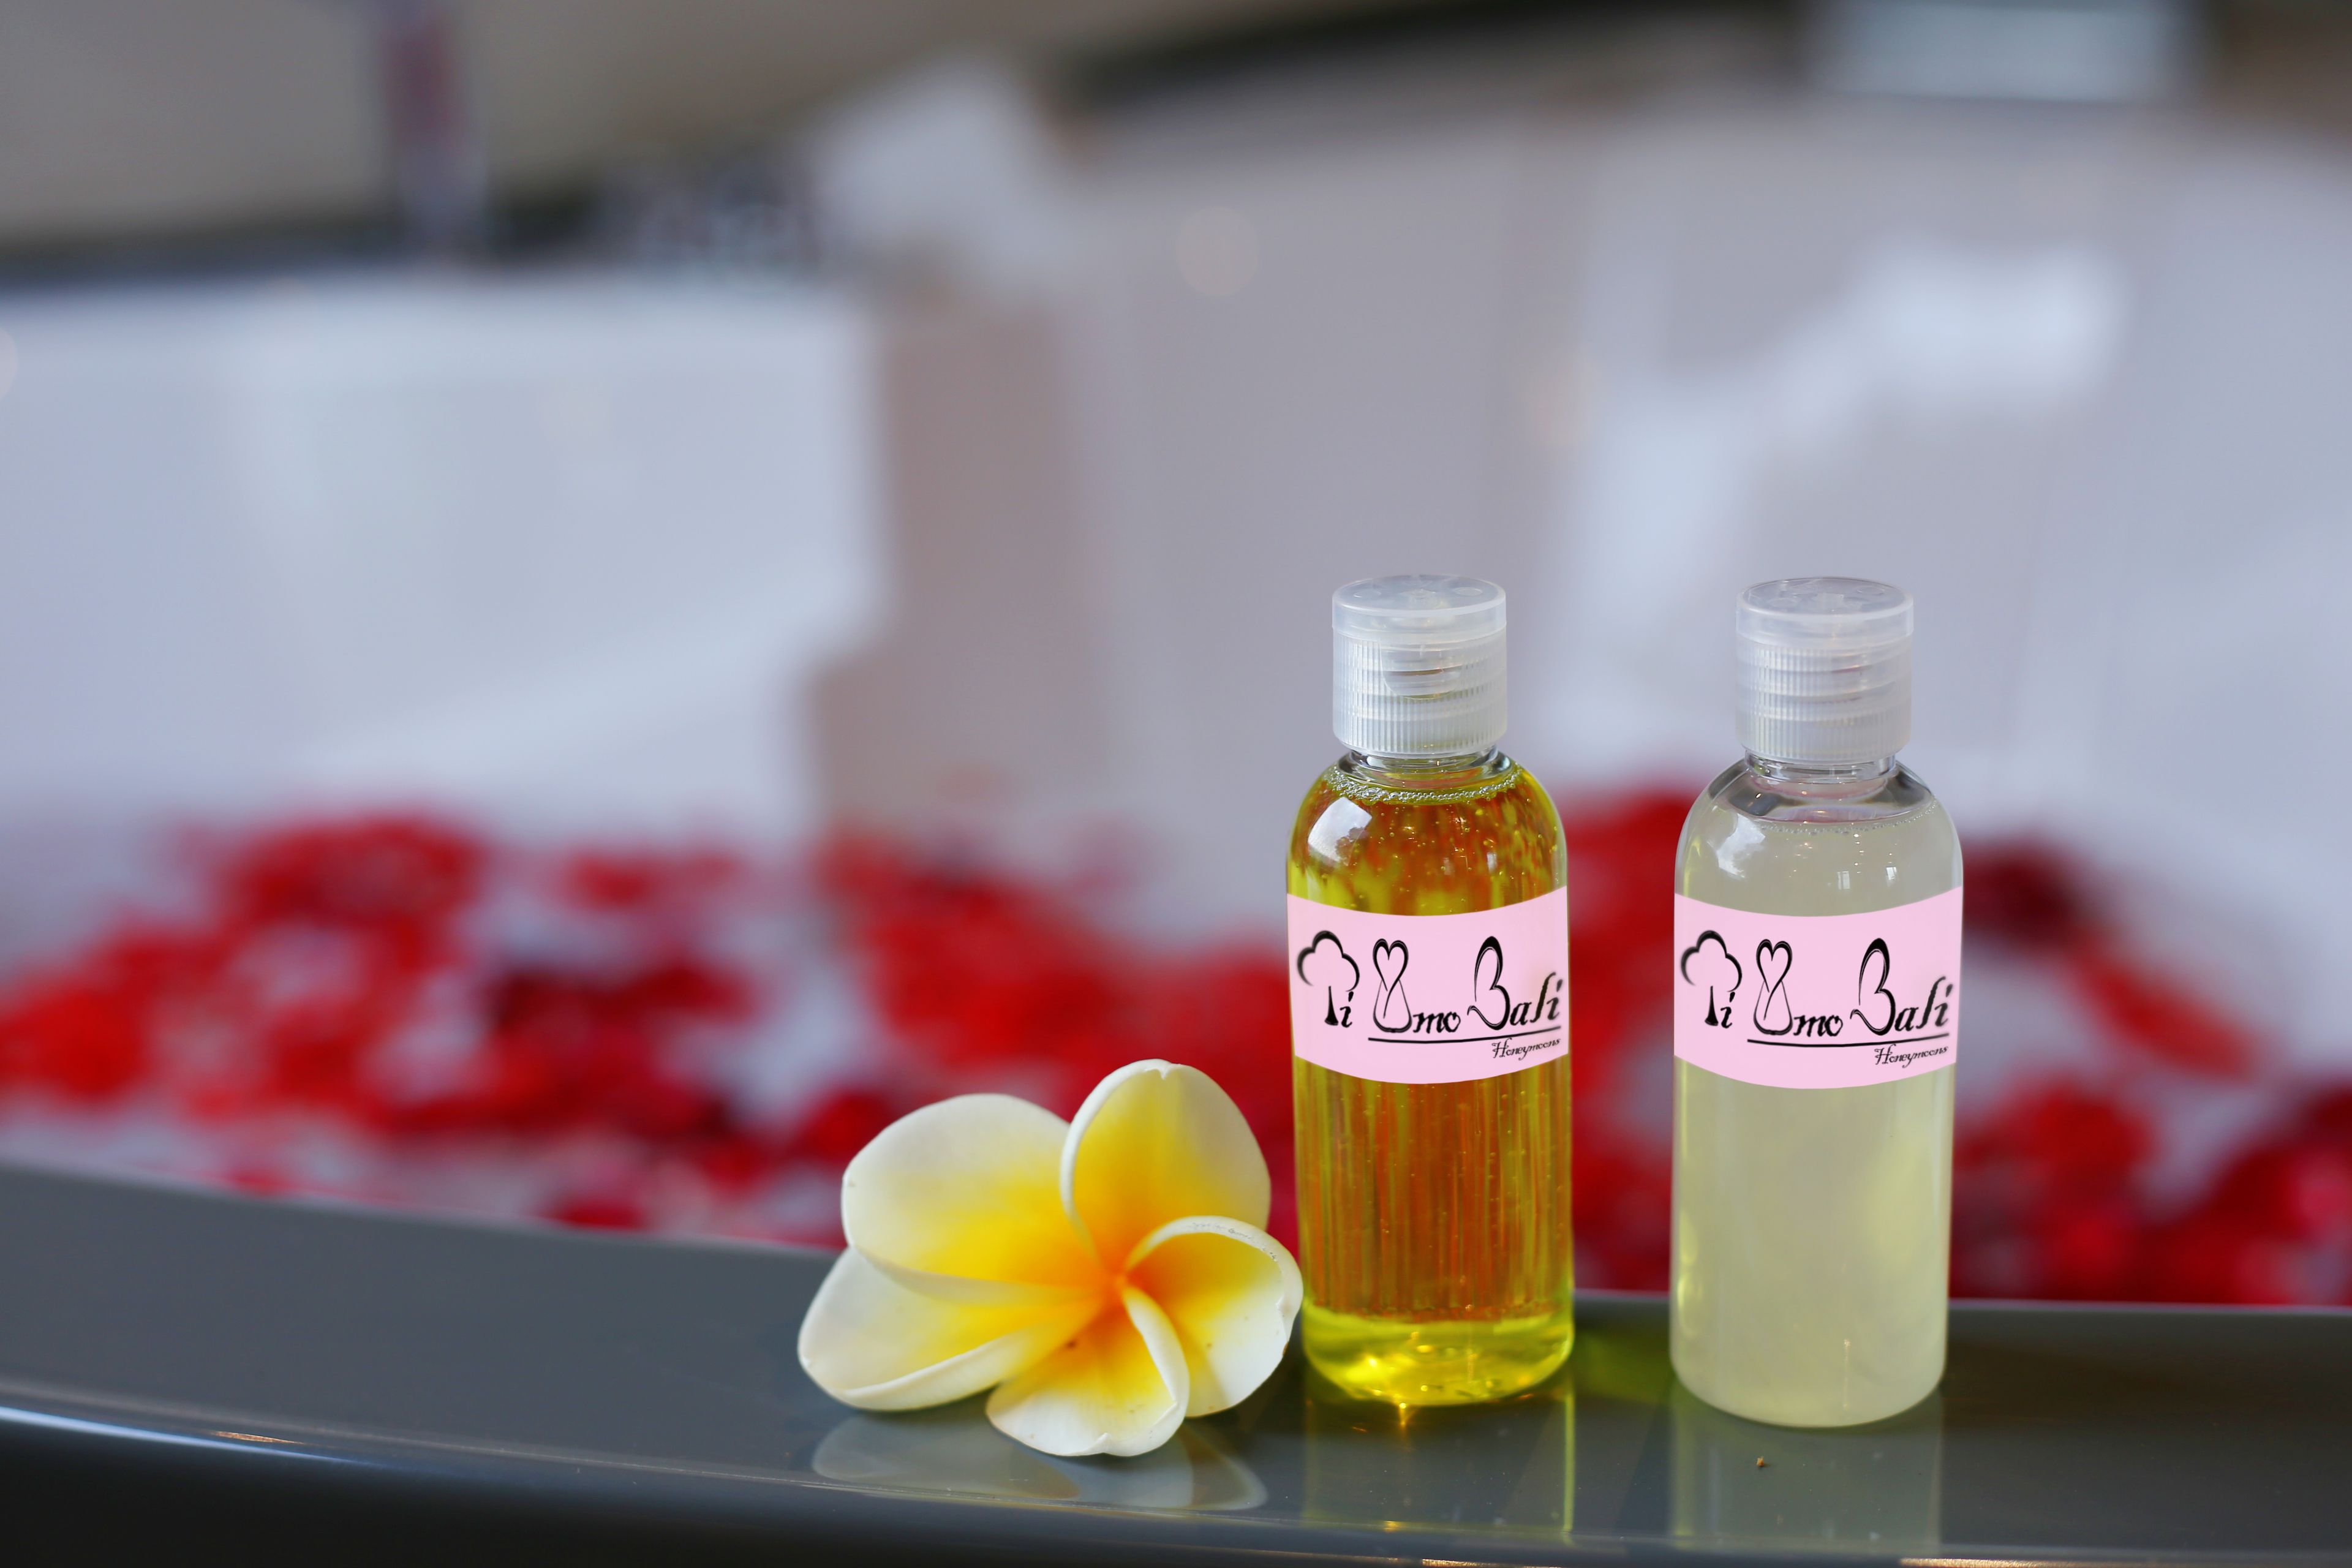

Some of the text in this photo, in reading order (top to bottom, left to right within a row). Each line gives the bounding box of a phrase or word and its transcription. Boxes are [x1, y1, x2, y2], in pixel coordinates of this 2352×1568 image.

[1467, 936, 1563, 1031] Bali
[1850, 938, 1953, 1036] Bali
[1491, 1038, 1561, 1061] Honeymoons
[1874, 1044, 1948, 1068] Honeymoons
